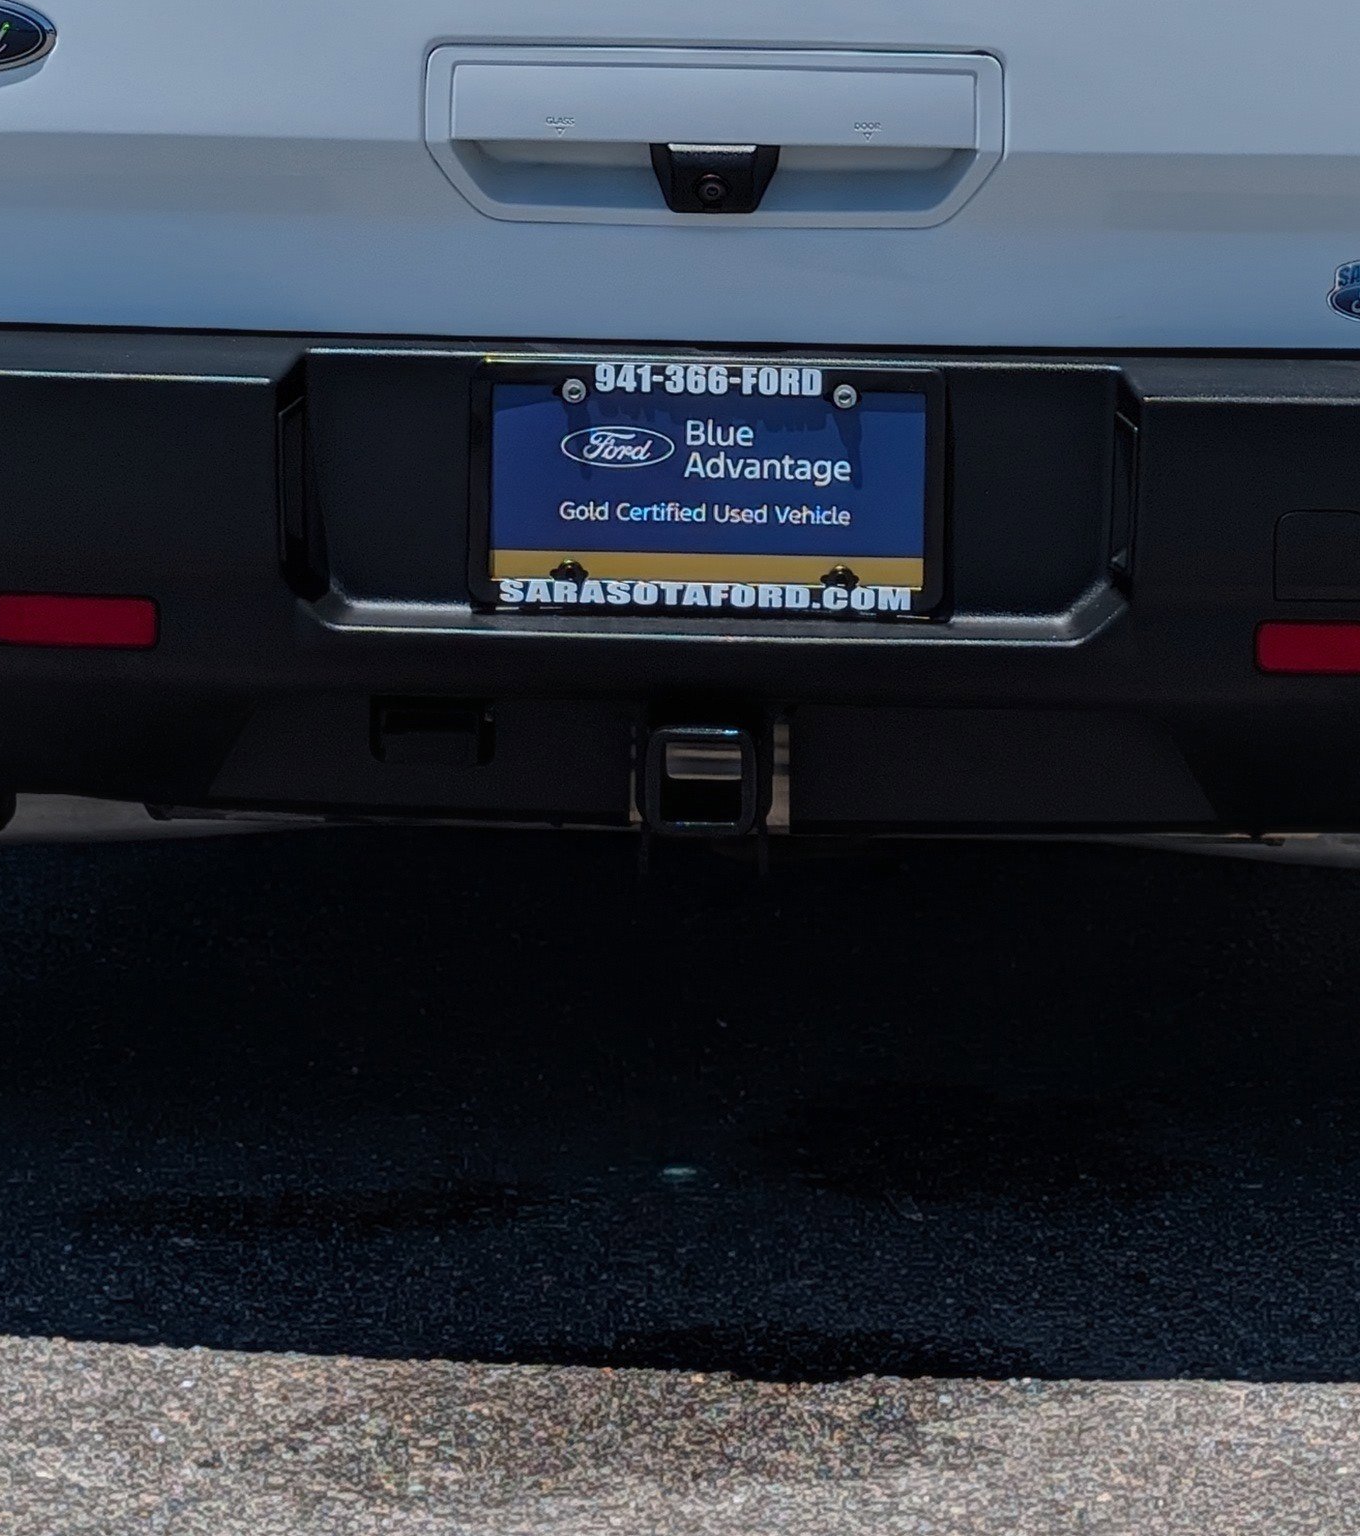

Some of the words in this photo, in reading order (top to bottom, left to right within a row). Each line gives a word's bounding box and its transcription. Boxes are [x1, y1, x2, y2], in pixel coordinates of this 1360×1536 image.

[545, 116, 576, 126] GLASS
[853, 122, 883, 132] DOOR
[594, 363, 823, 397] 941-366-FORD
[582, 431, 652, 462] Ford
[686, 419, 754, 447] Blue
[684, 452, 852, 487] Advantage
[559, 501, 610, 522] Gold
[616, 502, 706, 524] Certified
[713, 505, 768, 525] Used
[775, 505, 852, 526] Vehicle
[499, 579, 912, 612] SARASOTAFORD.COM
